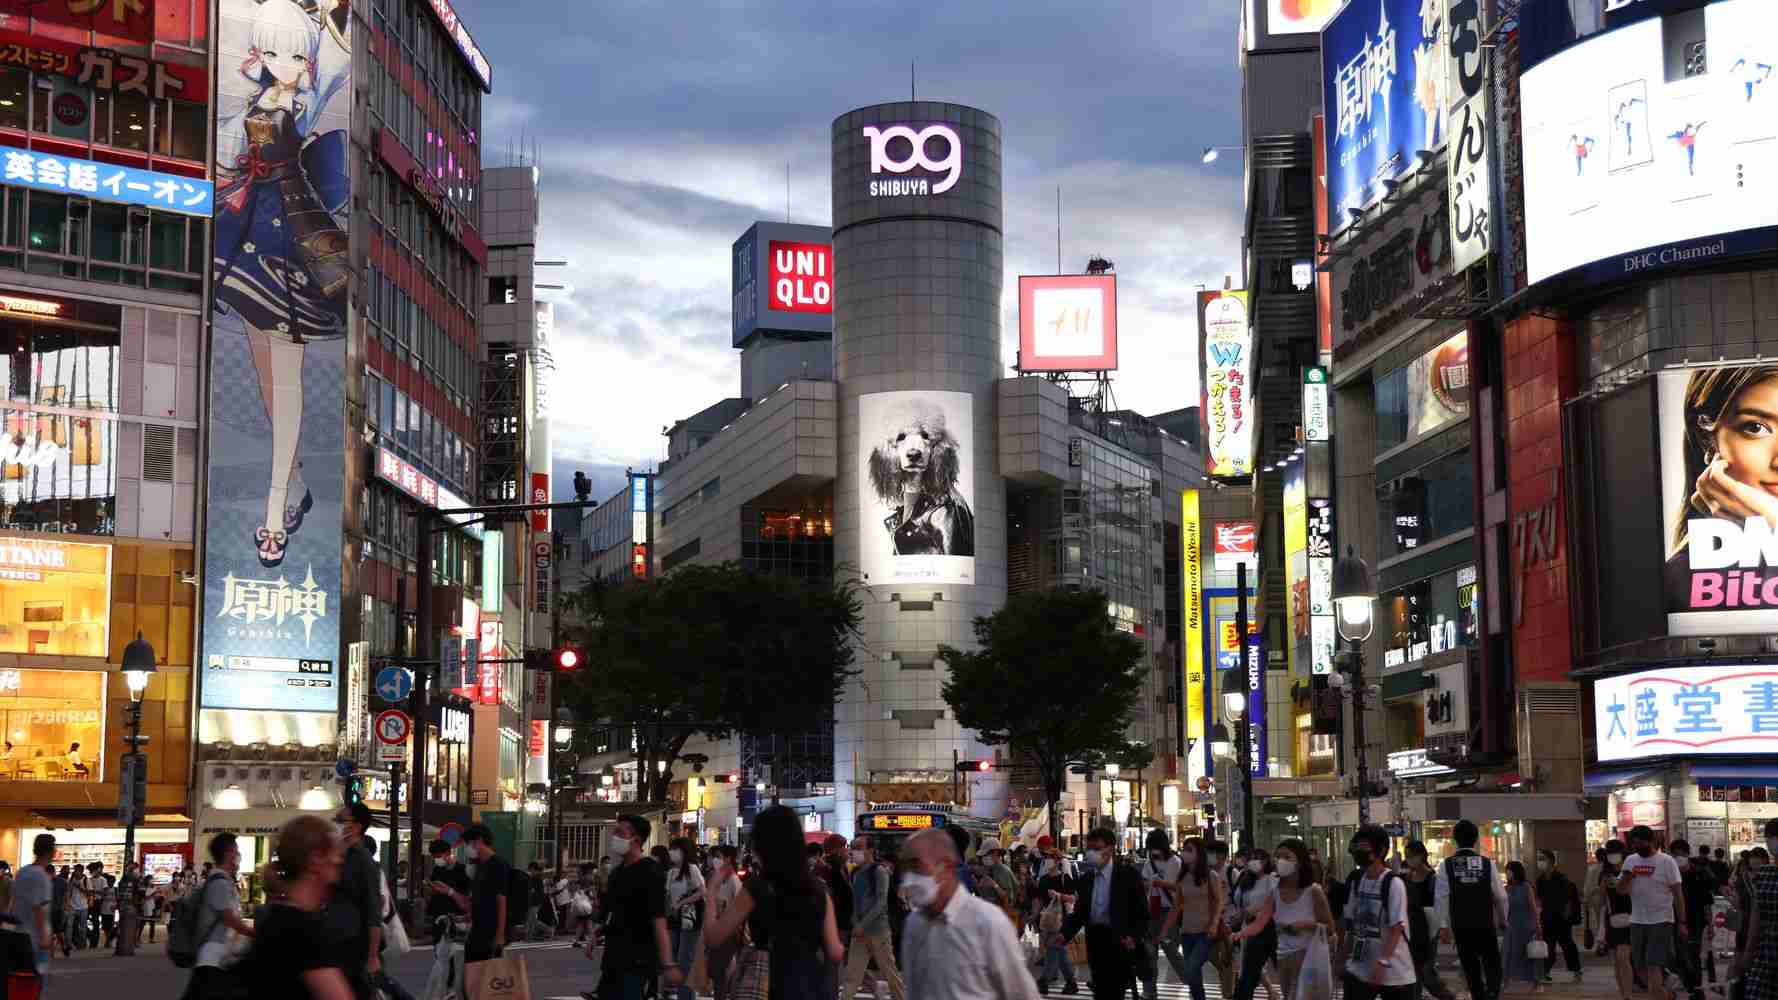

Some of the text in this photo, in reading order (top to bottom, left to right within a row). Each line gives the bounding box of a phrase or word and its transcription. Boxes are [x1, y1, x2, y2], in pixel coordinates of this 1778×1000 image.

[79, 52, 185, 97] ガスト
[863, 125, 962, 194] 109
[5, 152, 207, 206] 英会話イーオン
[869, 179, 929, 197] SHIBUYA
[776, 249, 825, 277] UNI
[1624, 239, 1726, 273] DHC Channel
[776, 278, 831, 307] QLO
[216, 562, 328, 649] 原神
[489, 977, 514, 991] GU
